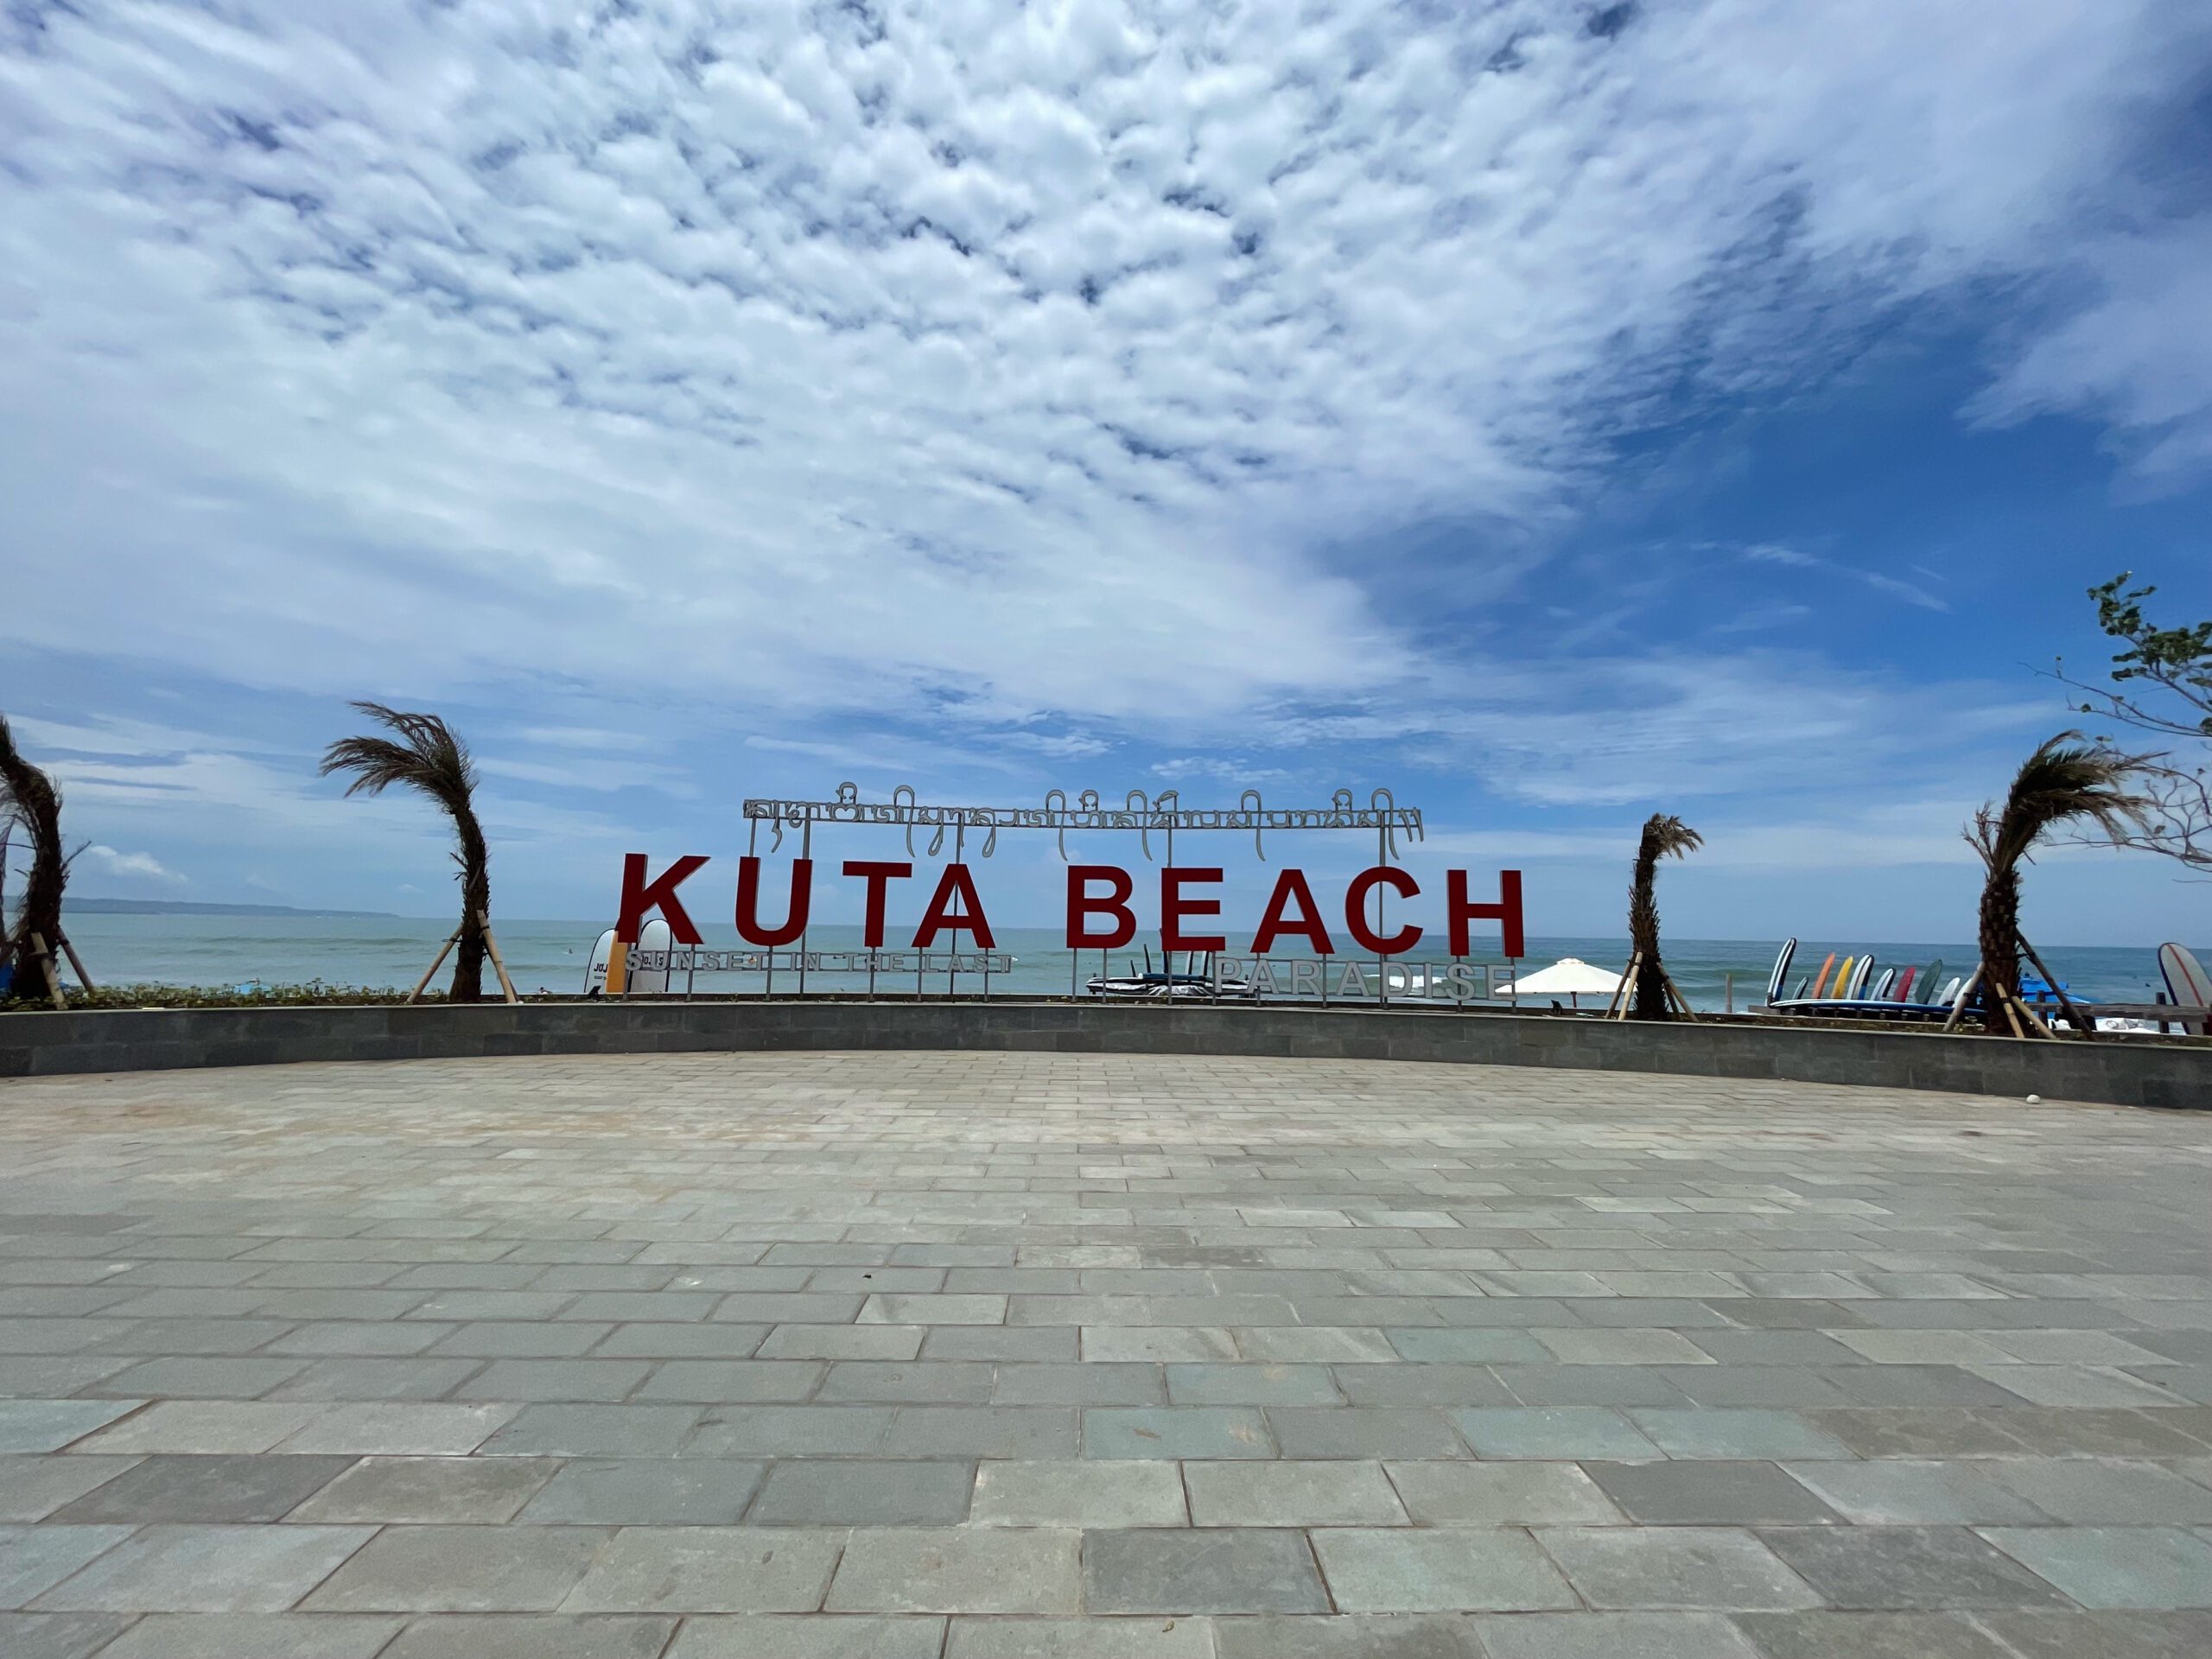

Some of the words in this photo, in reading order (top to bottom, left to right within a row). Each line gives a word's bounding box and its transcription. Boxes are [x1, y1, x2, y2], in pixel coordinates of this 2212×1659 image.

[617, 853, 995, 949] KUTA
[1066, 865, 1524, 957] BEACH
[626, 950, 768, 971] SUNSET
[790, 952, 820, 972] IN
[843, 953, 905, 972] THE
[922, 954, 1010, 974] LAST
[1215, 957, 1516, 1001] PARADISE
